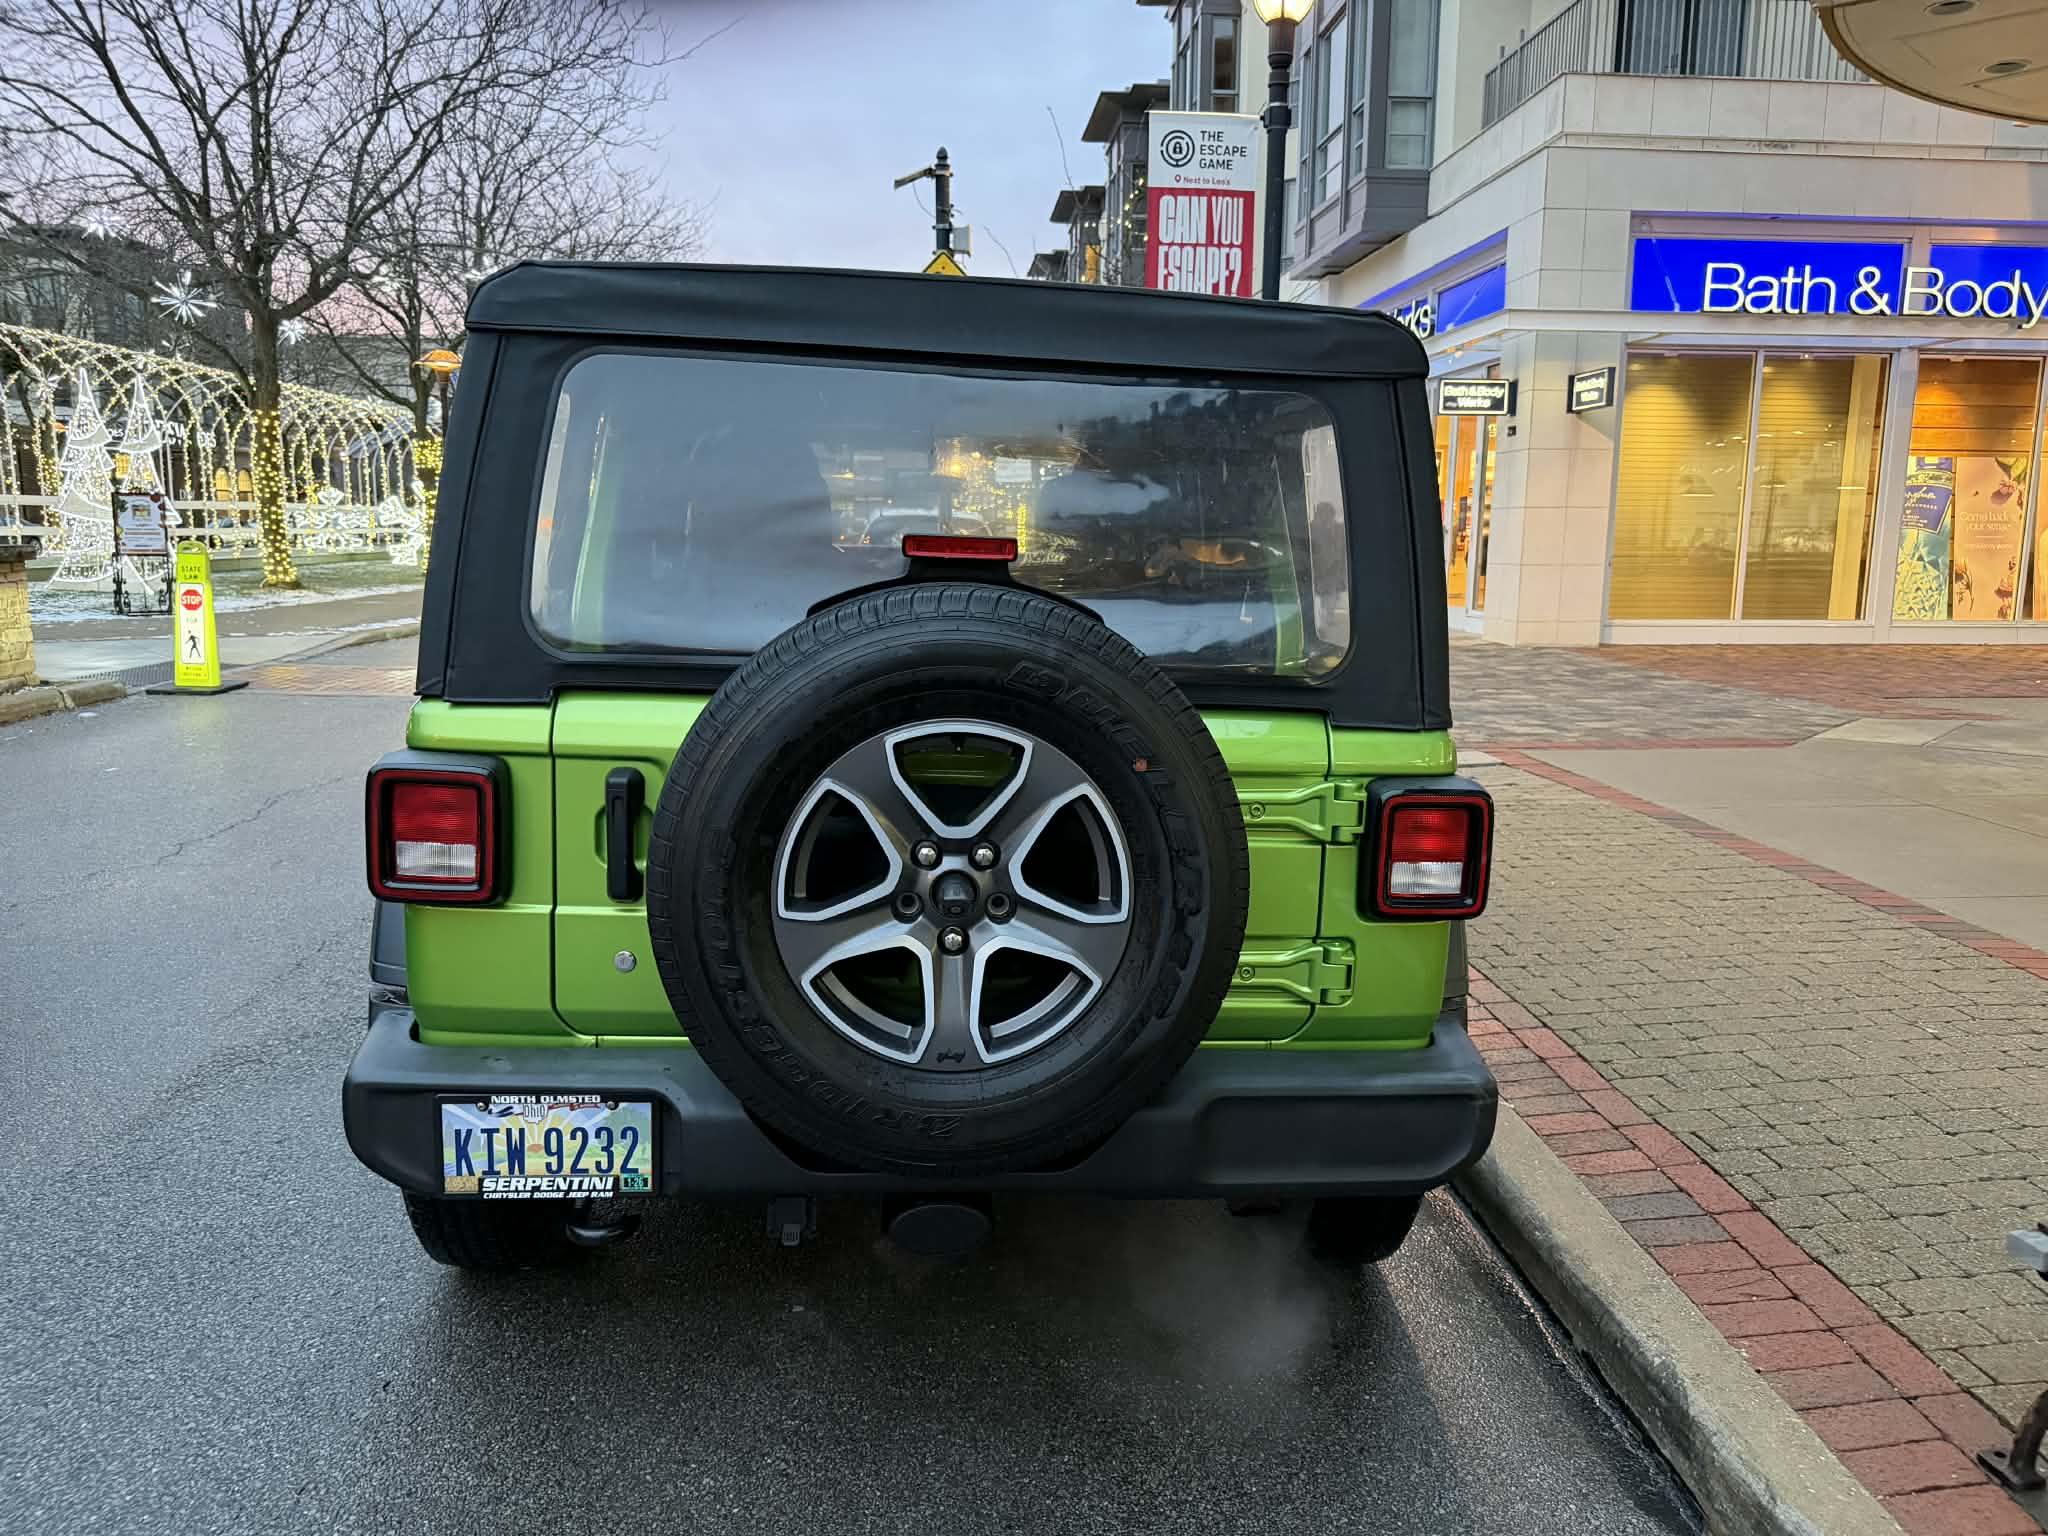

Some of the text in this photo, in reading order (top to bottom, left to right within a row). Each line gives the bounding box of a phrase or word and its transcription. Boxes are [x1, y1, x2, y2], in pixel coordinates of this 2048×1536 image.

[1200, 130, 1225, 143] THE
[1200, 144, 1247, 158] ESCAPE
[1200, 158, 1233, 171] GAME
[1183, 176, 1200, 184] Next
[1202, 176, 1210, 184] to
[1158, 195, 1244, 245] CAN YOU
[1157, 246, 1242, 296] ESCAPE?
[1703, 262, 2048, 329] Bath & Body
[181, 565, 201, 573] STATE
[181, 595, 202, 605] STOP
[491, 1094, 601, 1104] NORTH OLMSTED
[523, 1103, 546, 1118] Ohio
[454, 1126, 640, 1176] KIW 9232
[482, 1176, 614, 1192] SERPENTINI
[483, 1191, 613, 1199] CHRYSLER DODGE JEEP RAM
